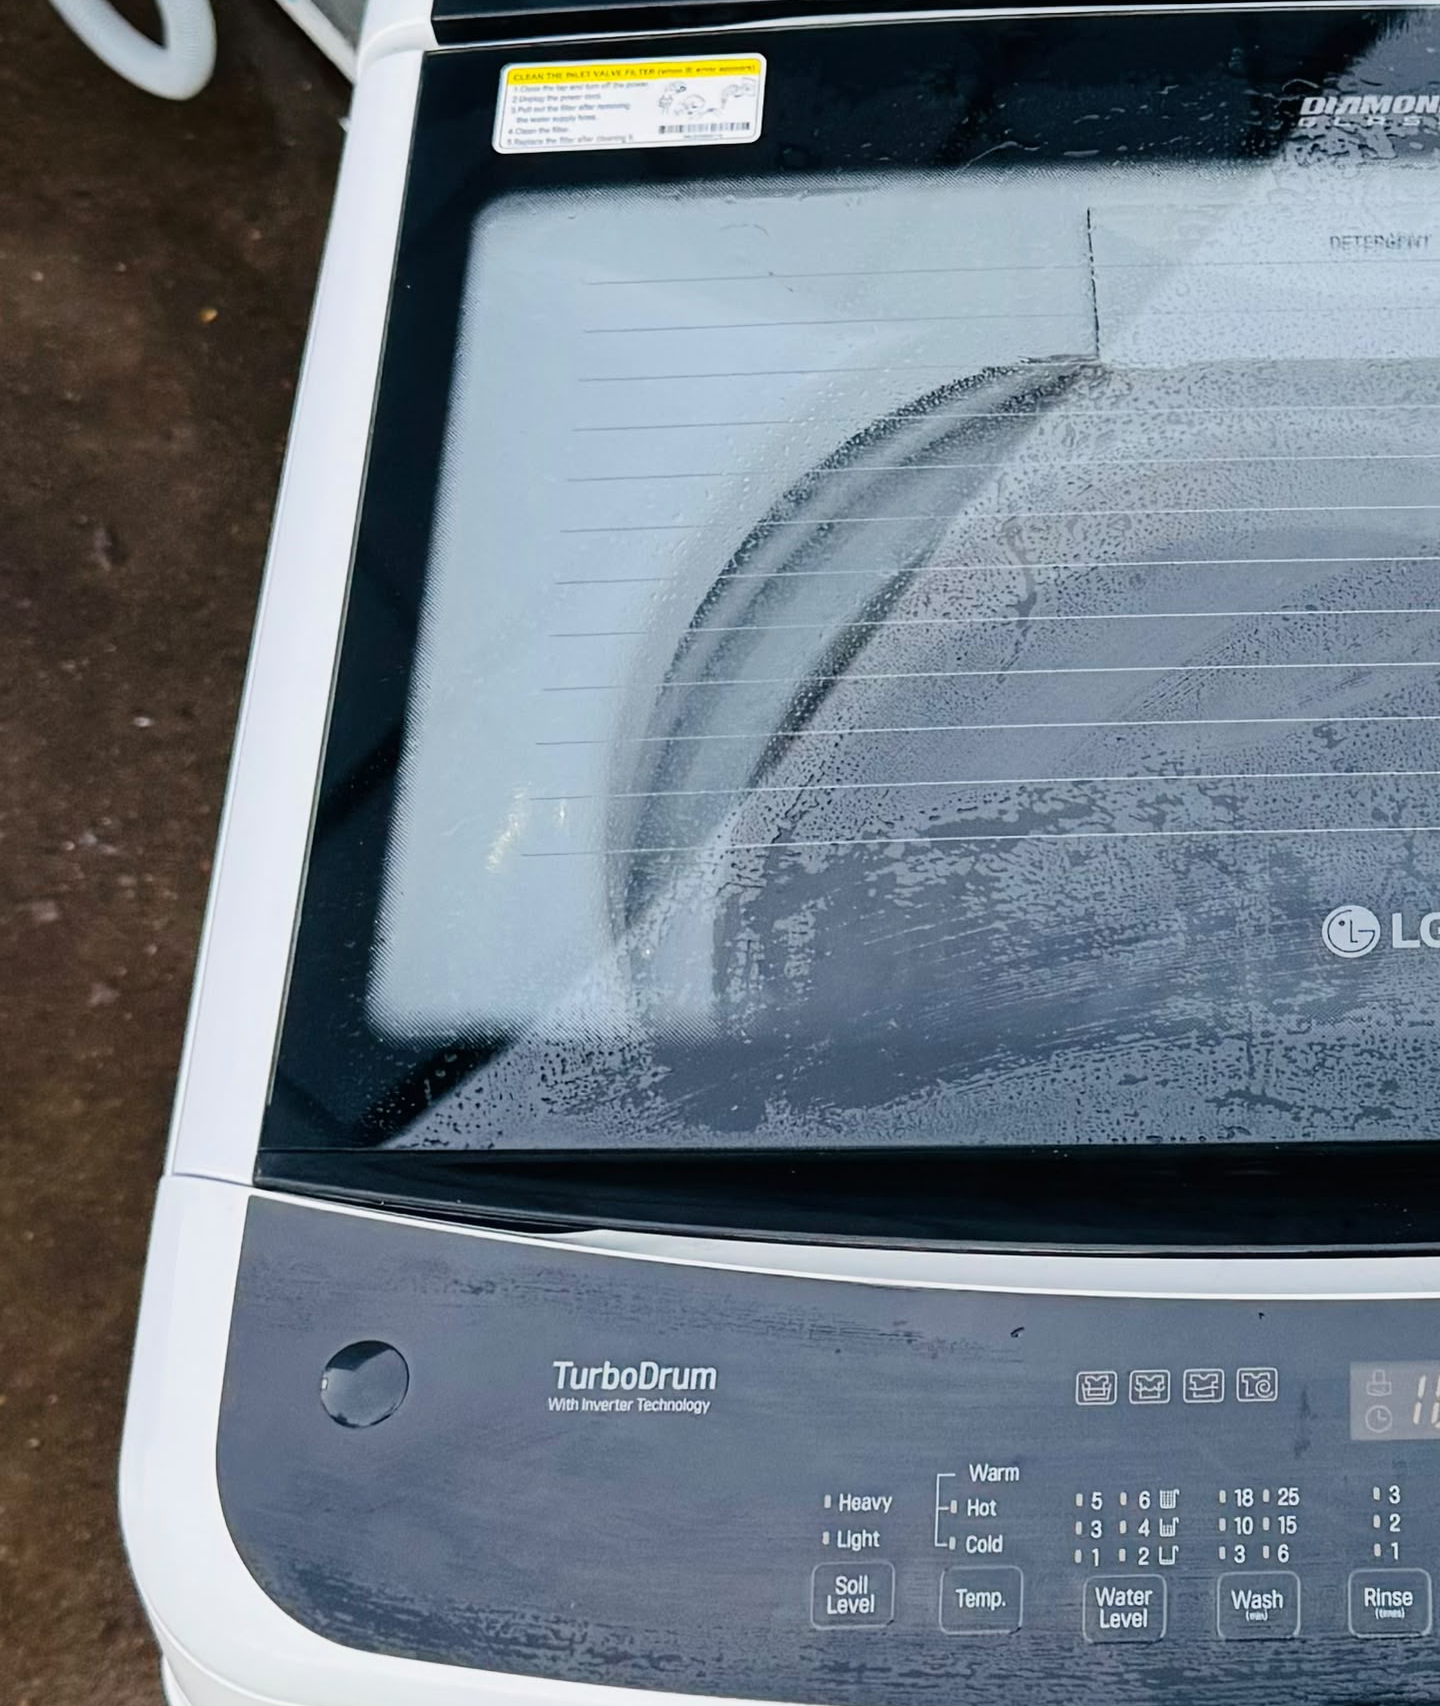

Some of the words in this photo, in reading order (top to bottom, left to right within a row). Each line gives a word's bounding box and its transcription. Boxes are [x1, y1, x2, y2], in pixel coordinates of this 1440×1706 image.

[552, 1360, 717, 1391] TurboDrum
[548, 1397, 579, 1412] With
[581, 1397, 634, 1412] Inverter
[636, 1397, 711, 1415] Technology
[969, 1463, 1020, 1483] Warm
[837, 1493, 894, 1514] Heavy
[1091, 1491, 1103, 1511] 5
[1138, 1490, 1151, 1510] 6
[1234, 1488, 1254, 1508] 18
[1277, 1487, 1300, 1506] 25
[1388, 1484, 1401, 1504] 3
[967, 1498, 997, 1517] Hot
[1090, 1519, 1103, 1539] 3
[1137, 1518, 1151, 1537] 4
[1233, 1516, 1254, 1535] 10
[1277, 1515, 1298, 1535] 15
[1389, 1513, 1401, 1533] 2
[837, 1529, 881, 1552] Light
[965, 1534, 1003, 1554] Cold
[1390, 1541, 1399, 1560] 1
[1091, 1548, 1099, 1567] 1
[1138, 1546, 1150, 1566] 2
[1233, 1544, 1246, 1564] 3
[1277, 1543, 1290, 1563] 6
[835, 1574, 869, 1596] Soil
[826, 1593, 875, 1615] Level
[955, 1588, 1006, 1611] Temp.
[1094, 1586, 1154, 1607] Water
[1231, 1589, 1284, 1609] Wash
[1364, 1587, 1414, 1607] Rinse
[1099, 1608, 1148, 1629] Level
